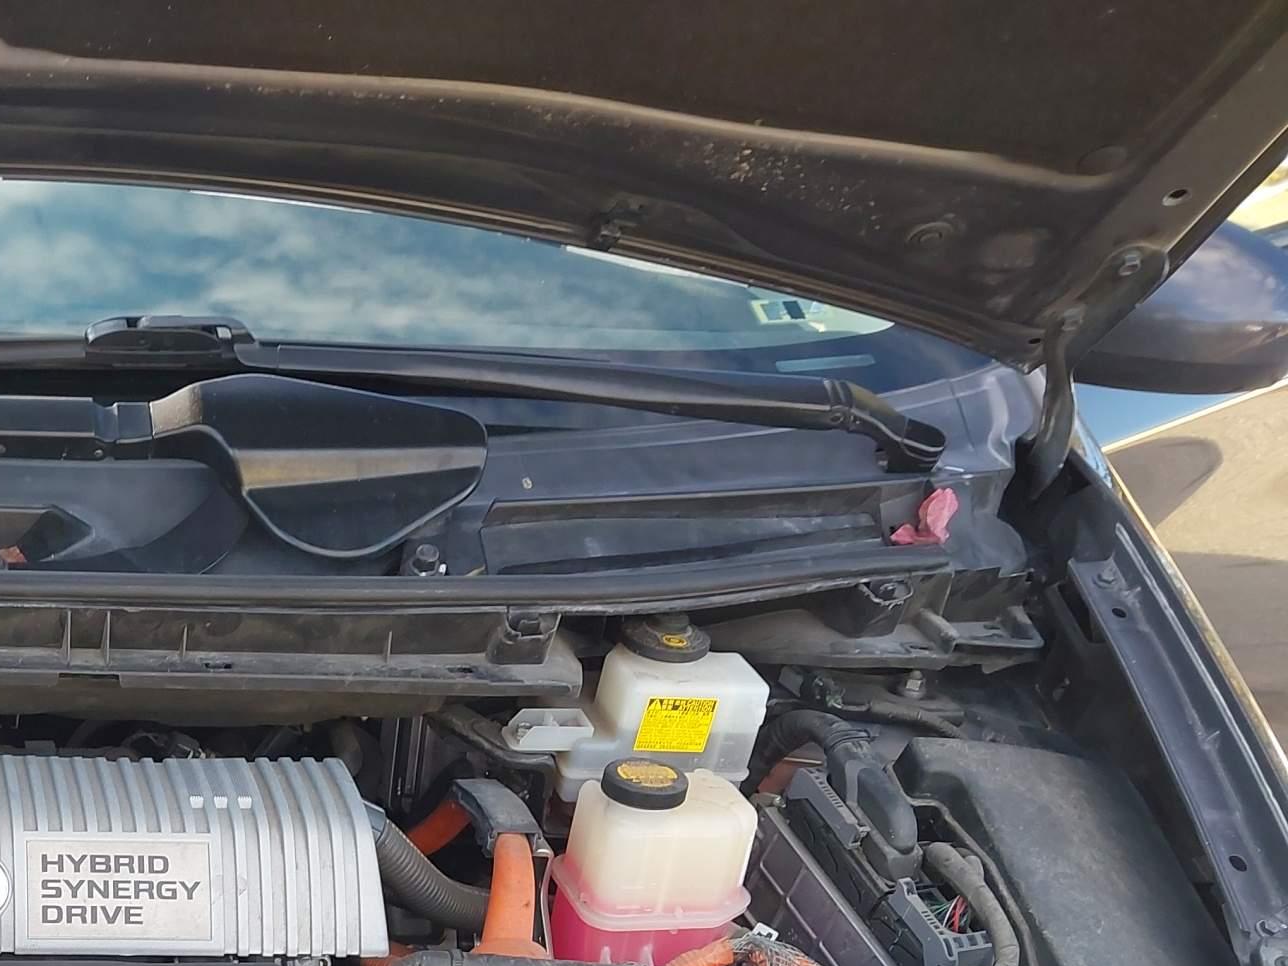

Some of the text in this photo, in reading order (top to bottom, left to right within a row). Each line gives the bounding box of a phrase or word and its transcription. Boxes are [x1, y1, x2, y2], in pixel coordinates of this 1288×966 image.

[41, 853, 170, 875] HYBRID
[41, 878, 201, 901] SYNERGY
[41, 904, 144, 926] DRIVE
